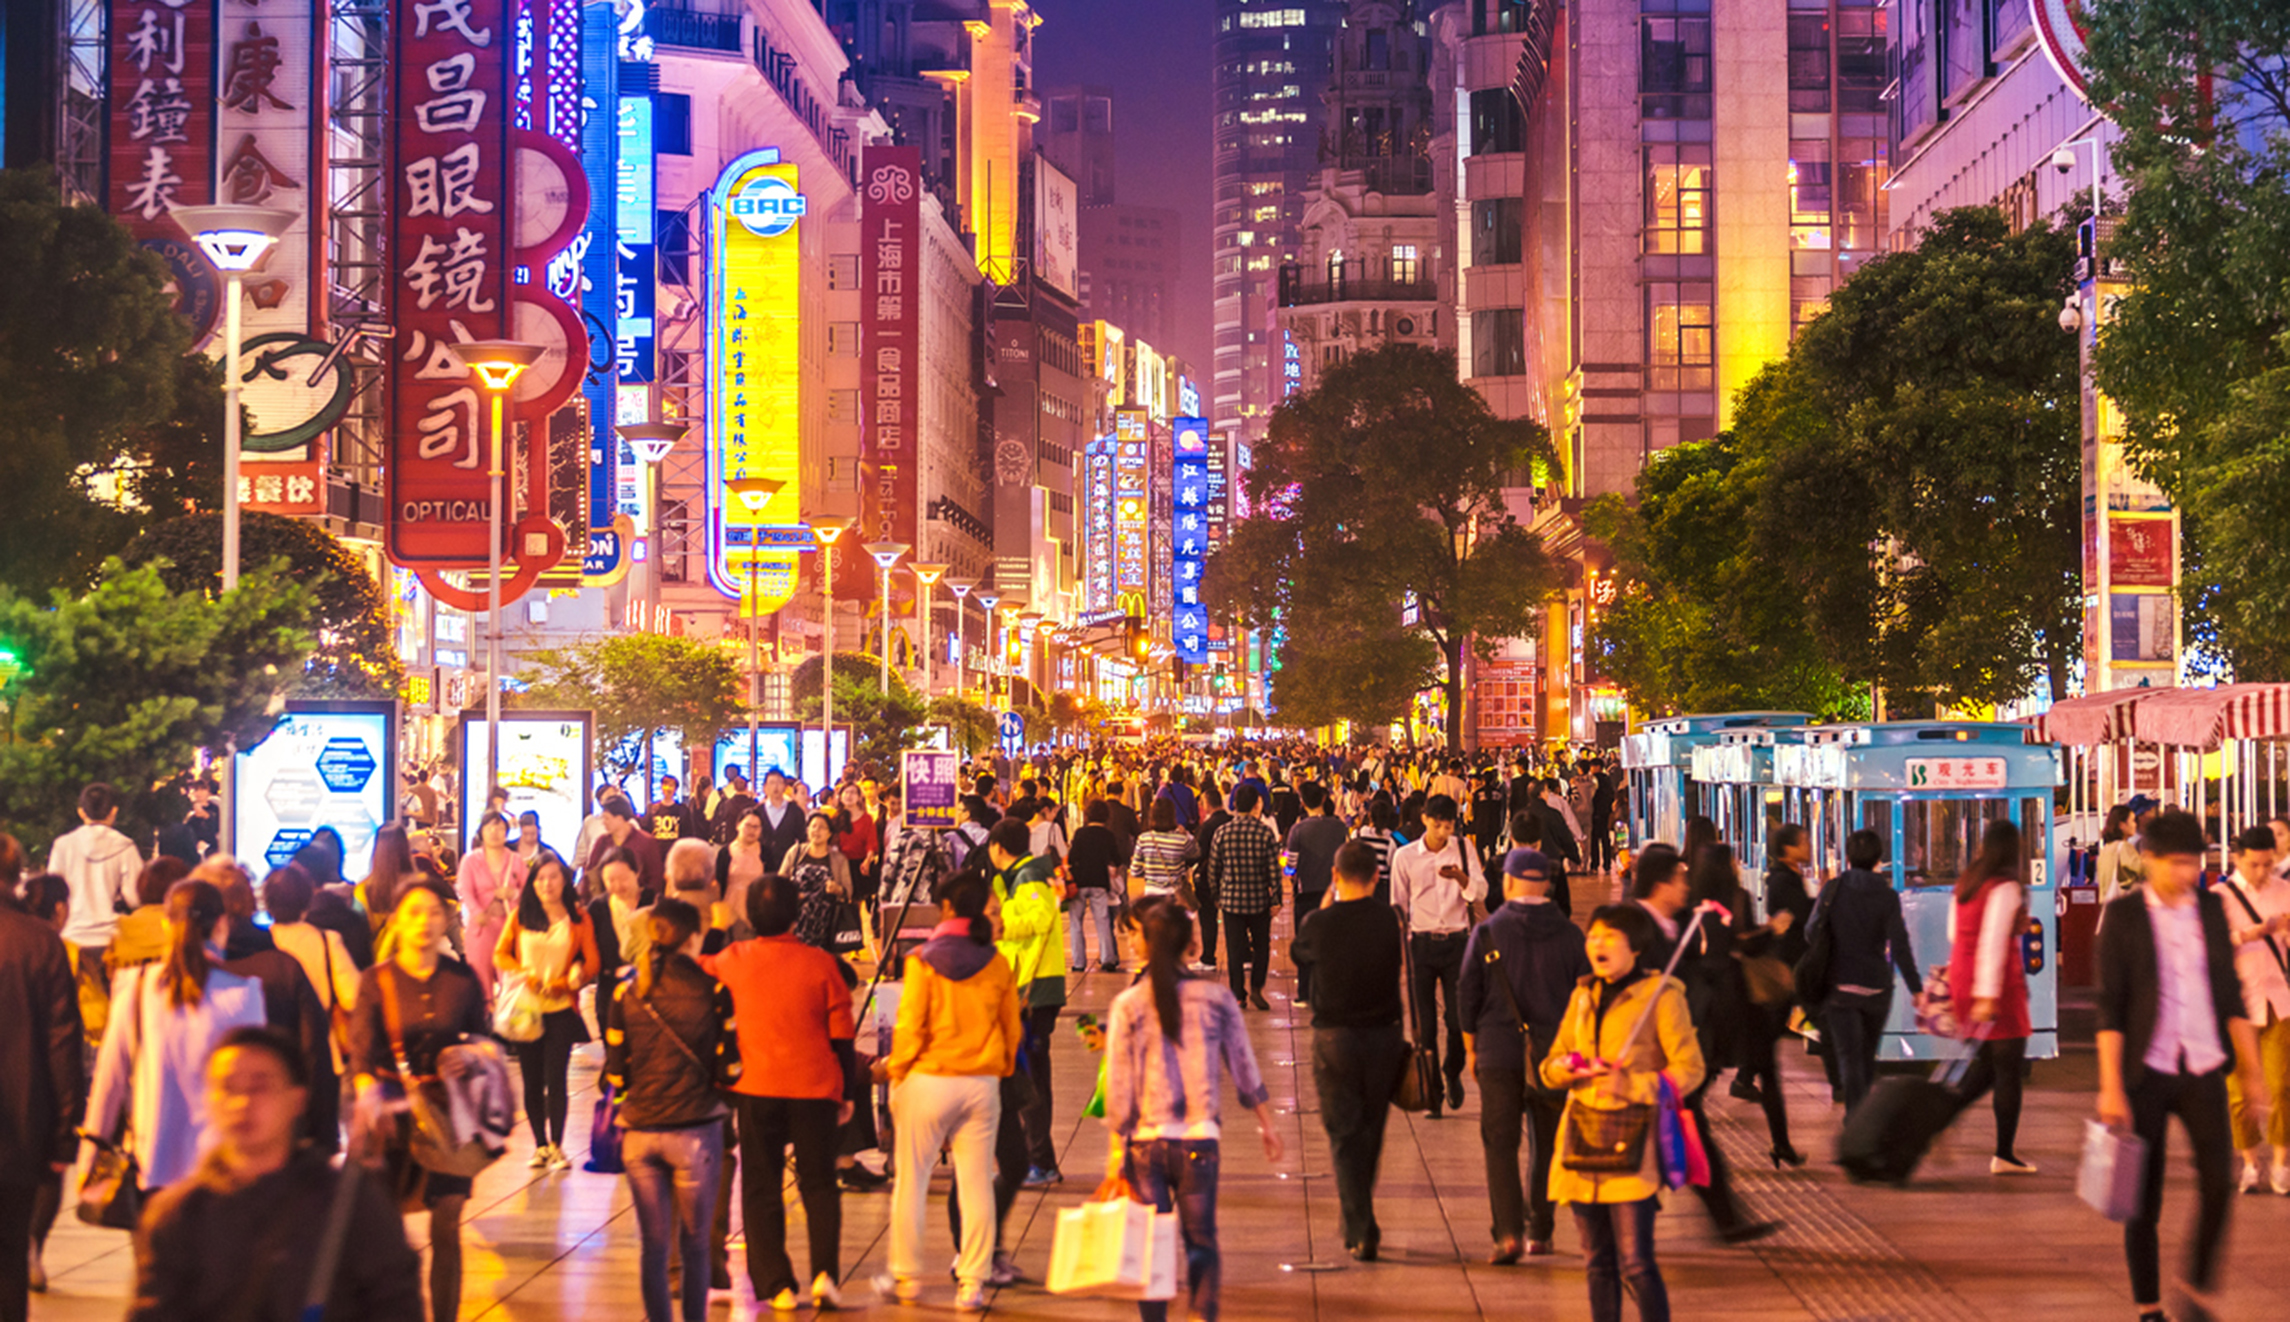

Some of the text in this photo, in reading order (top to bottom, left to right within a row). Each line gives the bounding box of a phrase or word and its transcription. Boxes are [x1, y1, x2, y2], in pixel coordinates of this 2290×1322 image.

[122, 0, 192, 221] 利鐘表
[733, 198, 804, 215] BAC
[876, 218, 903, 450] 上海市第一食品商店
[1001, 348, 1029, 358] TITONI
[403, 501, 491, 523] OPTICAL
[880, 465, 897, 543] First Foo
[907, 755, 956, 785] 快照
[1937, 762, 1999, 777] 观光车
[2034, 863, 2043, 882] 2
